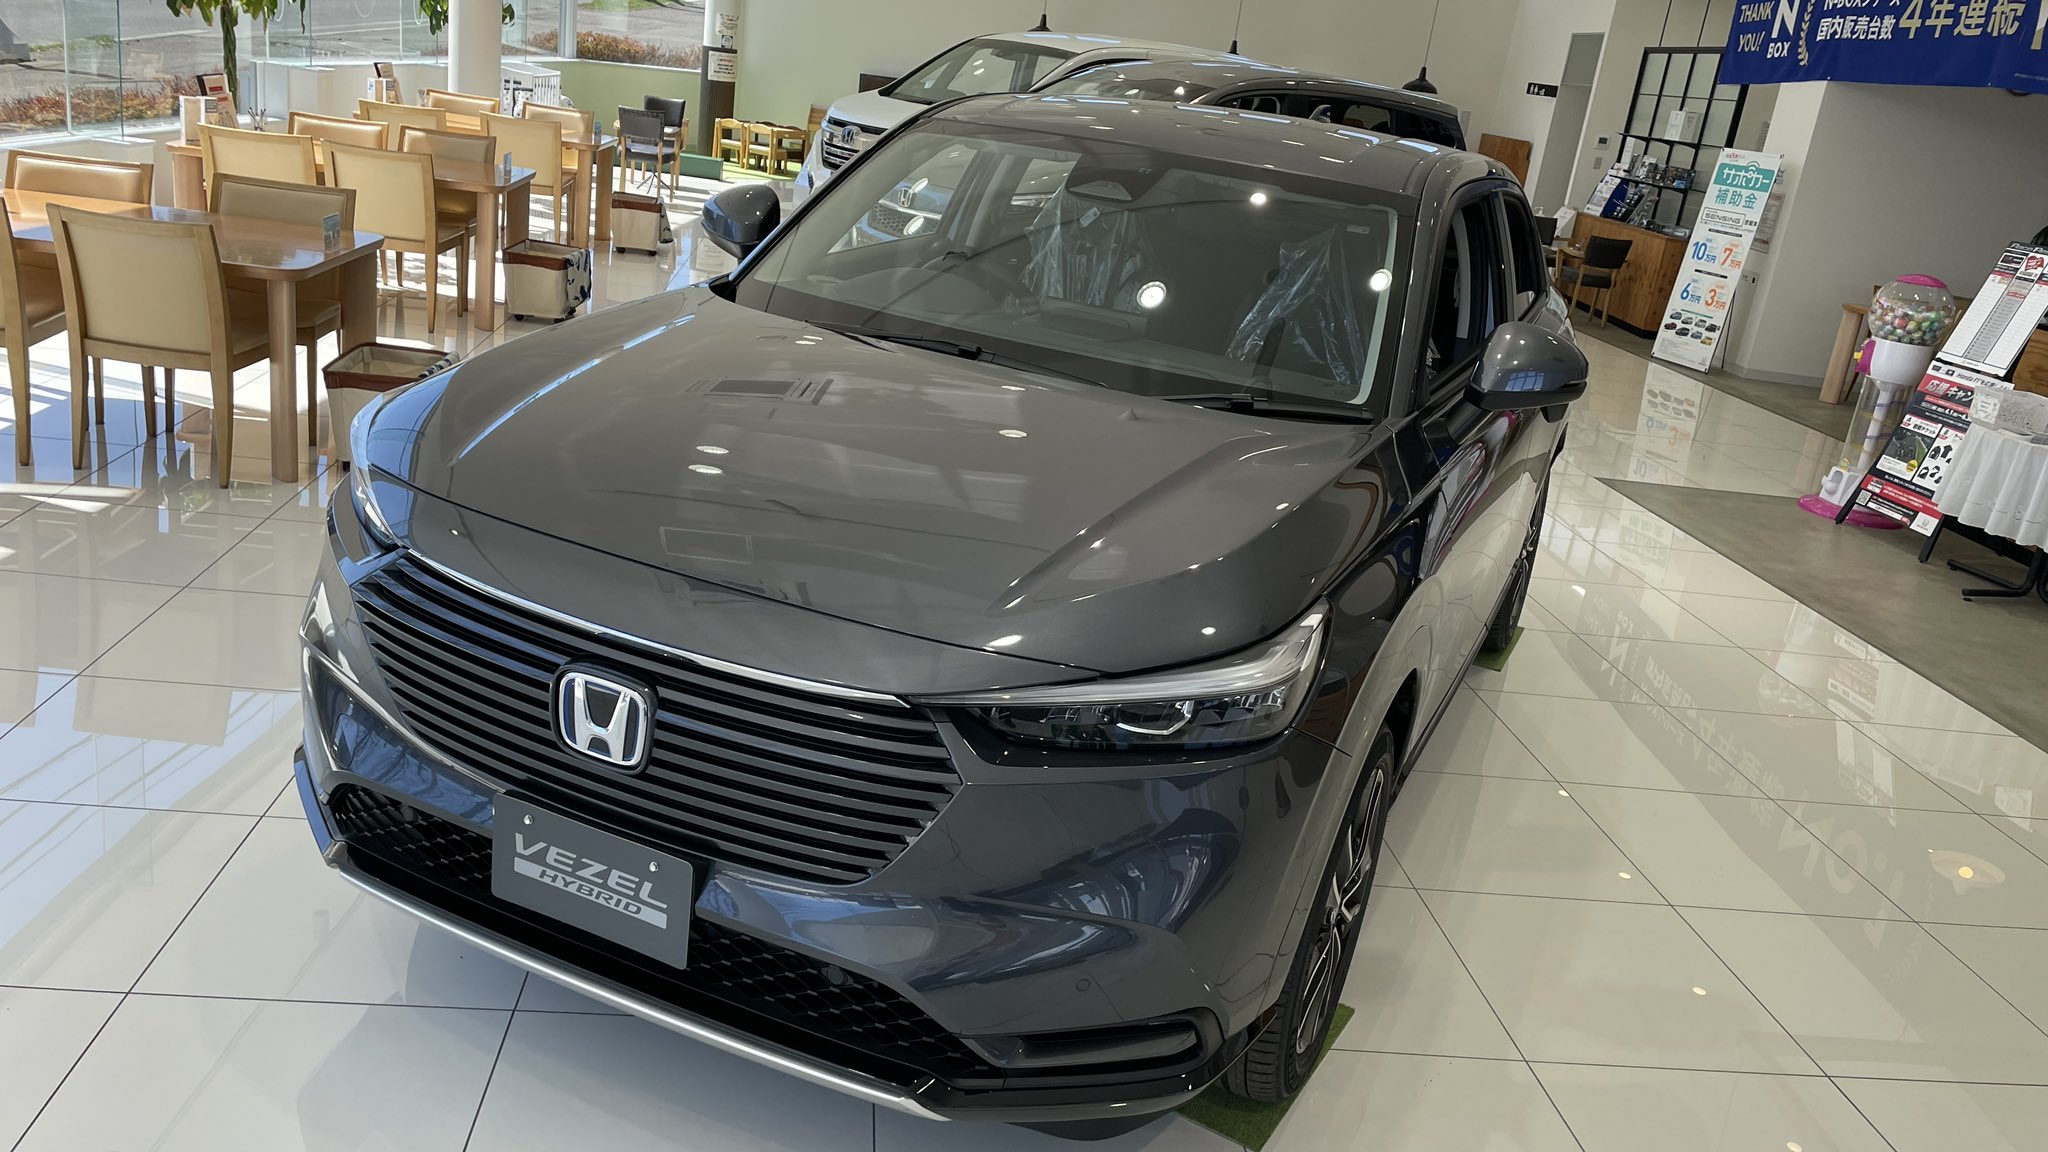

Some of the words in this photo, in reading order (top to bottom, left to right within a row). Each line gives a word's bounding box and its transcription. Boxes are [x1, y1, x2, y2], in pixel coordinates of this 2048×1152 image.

[1739, 1, 1775, 23] THANK
[1816, 15, 1897, 42] 国内販売台数
[1737, 31, 1766, 52] YOU!
[1766, 41, 1791, 58] BOX
[1723, 167, 1771, 188] サポカー
[1715, 187, 1758, 209] 補助金
[1704, 212, 1742, 225] SENSING
[515, 832, 668, 909] VEZEL
[538, 869, 642, 915] HYBRID
